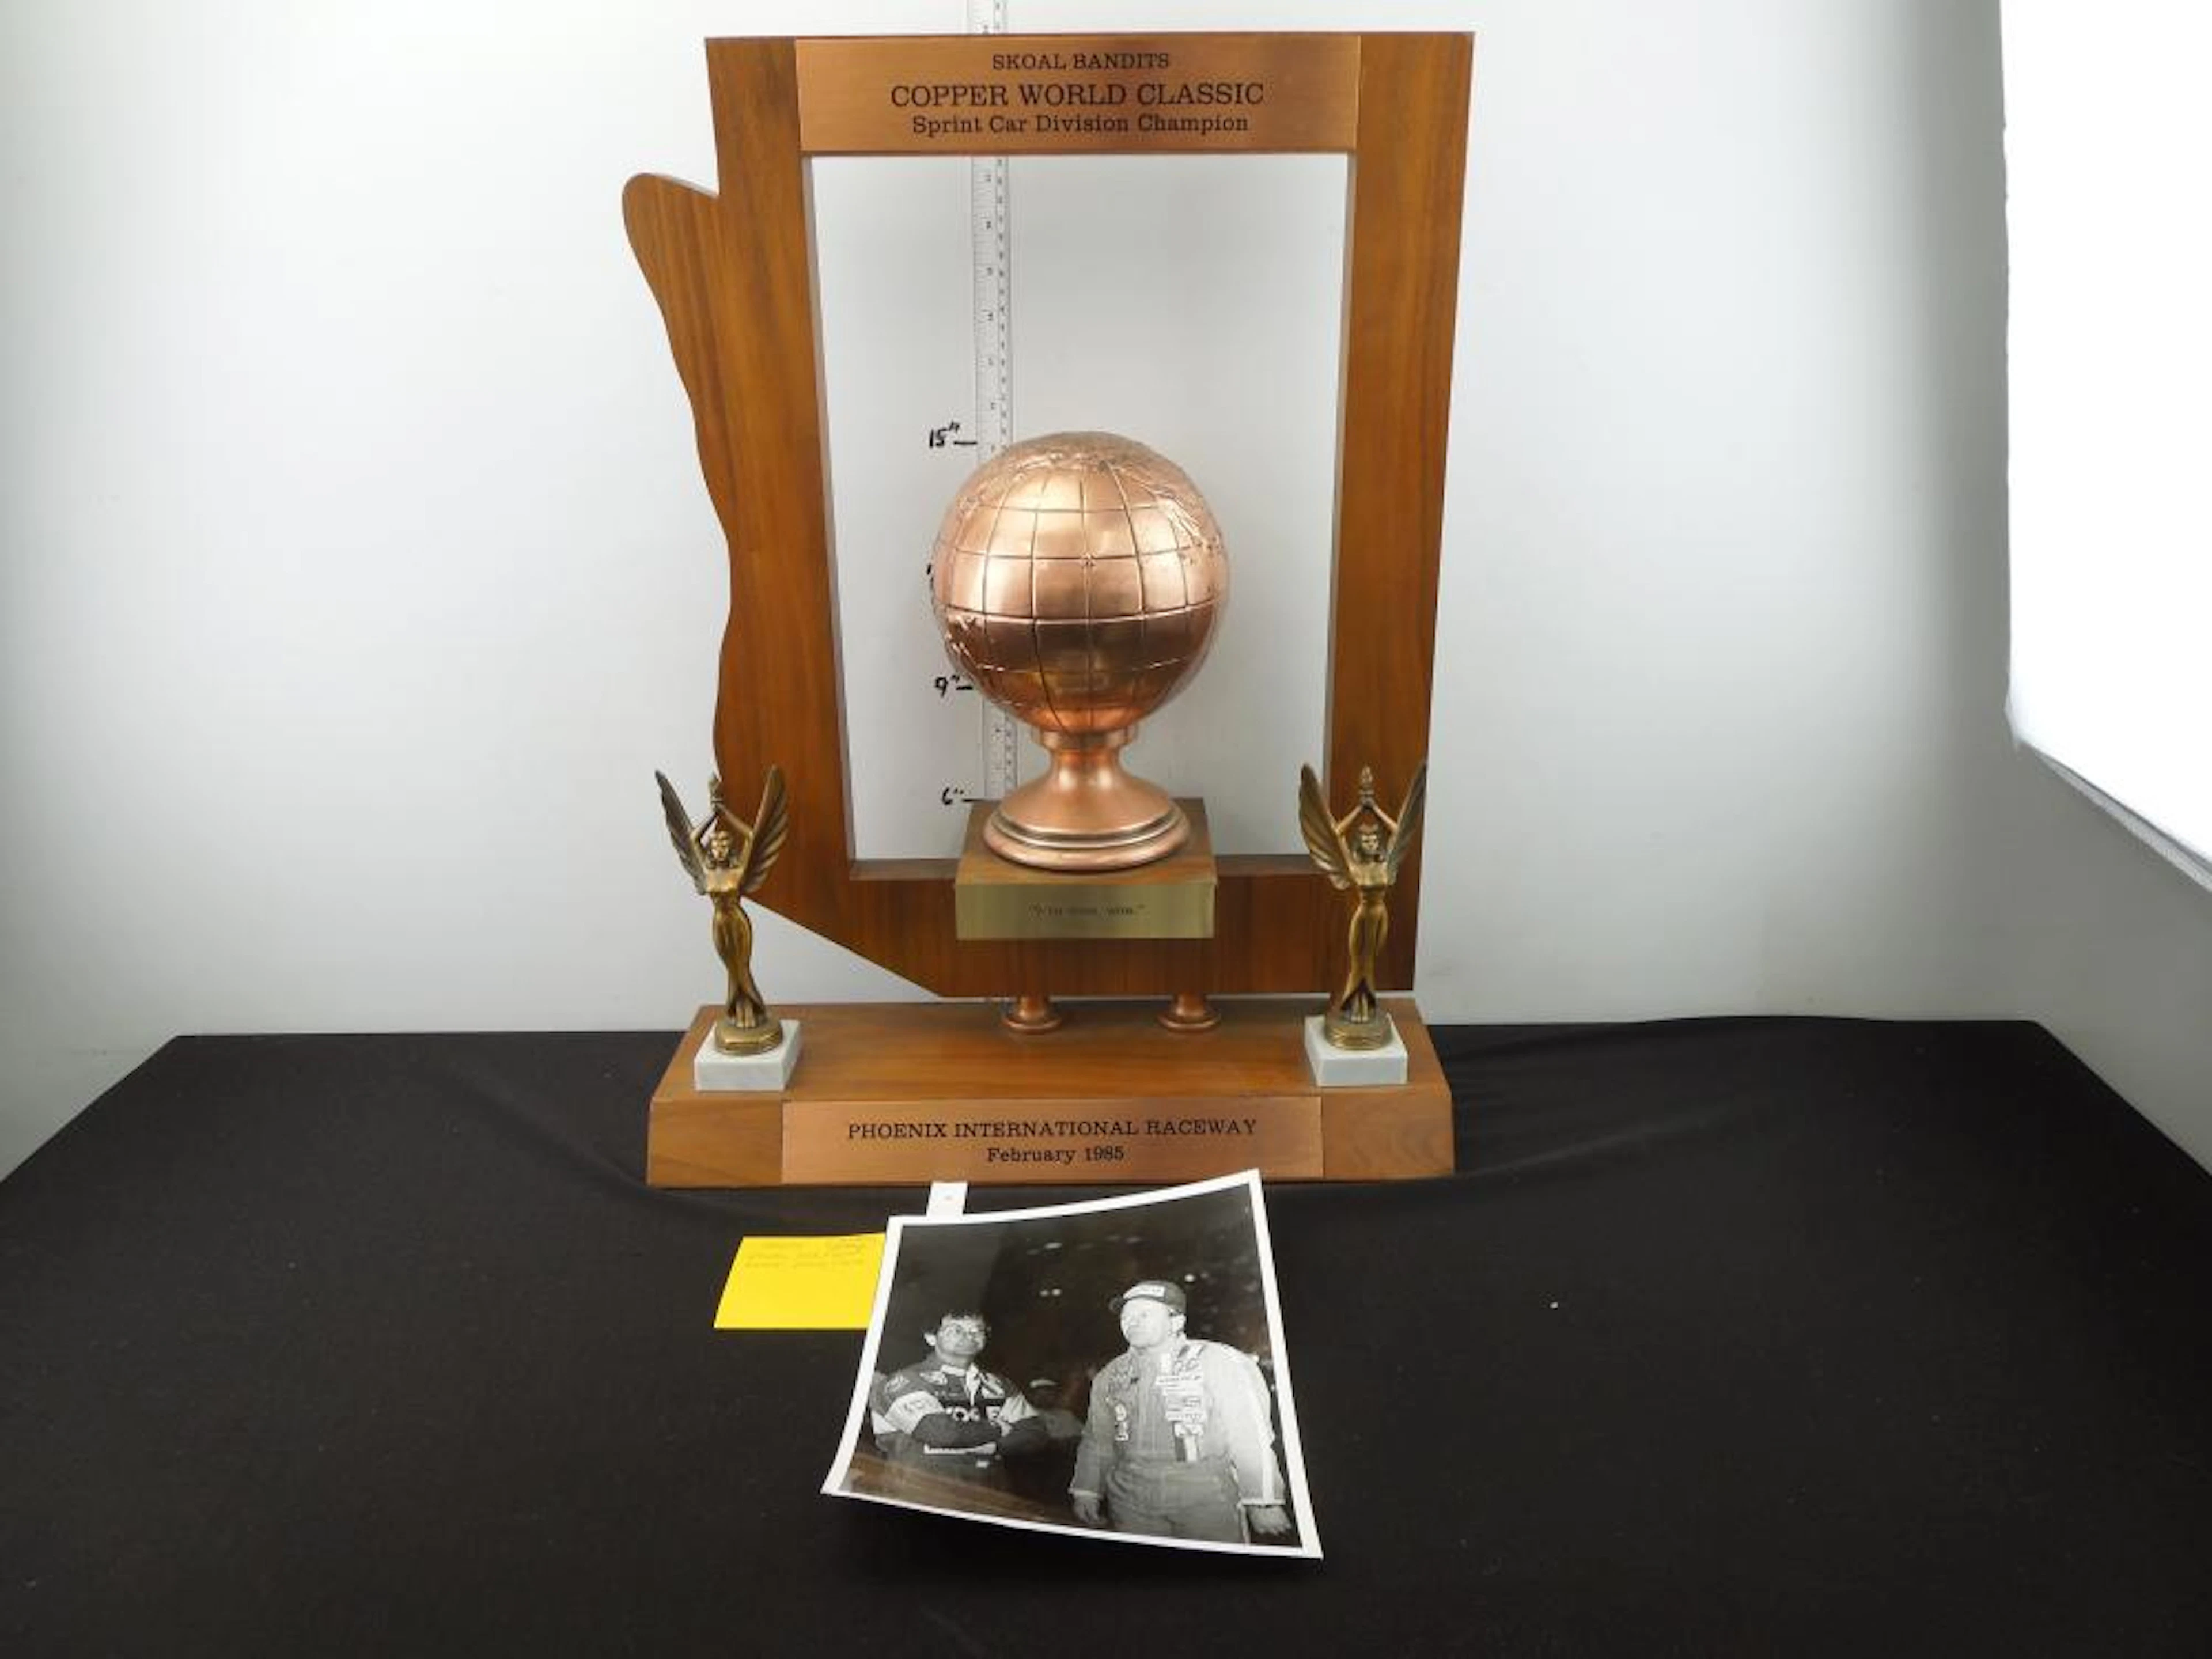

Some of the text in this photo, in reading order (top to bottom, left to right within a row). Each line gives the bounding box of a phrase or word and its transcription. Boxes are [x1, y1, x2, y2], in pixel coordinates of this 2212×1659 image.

[993, 53, 1169, 70] SKOAL BANDITS
[891, 82, 1263, 107] COPPER WORLD CLASSIC
[913, 113, 1248, 138] Sprint Car Division Champion
[848, 1119, 1256, 1139] PHOENIX INTERNATIONAL RACEWAY
[987, 1146, 1124, 1165] February 1985
